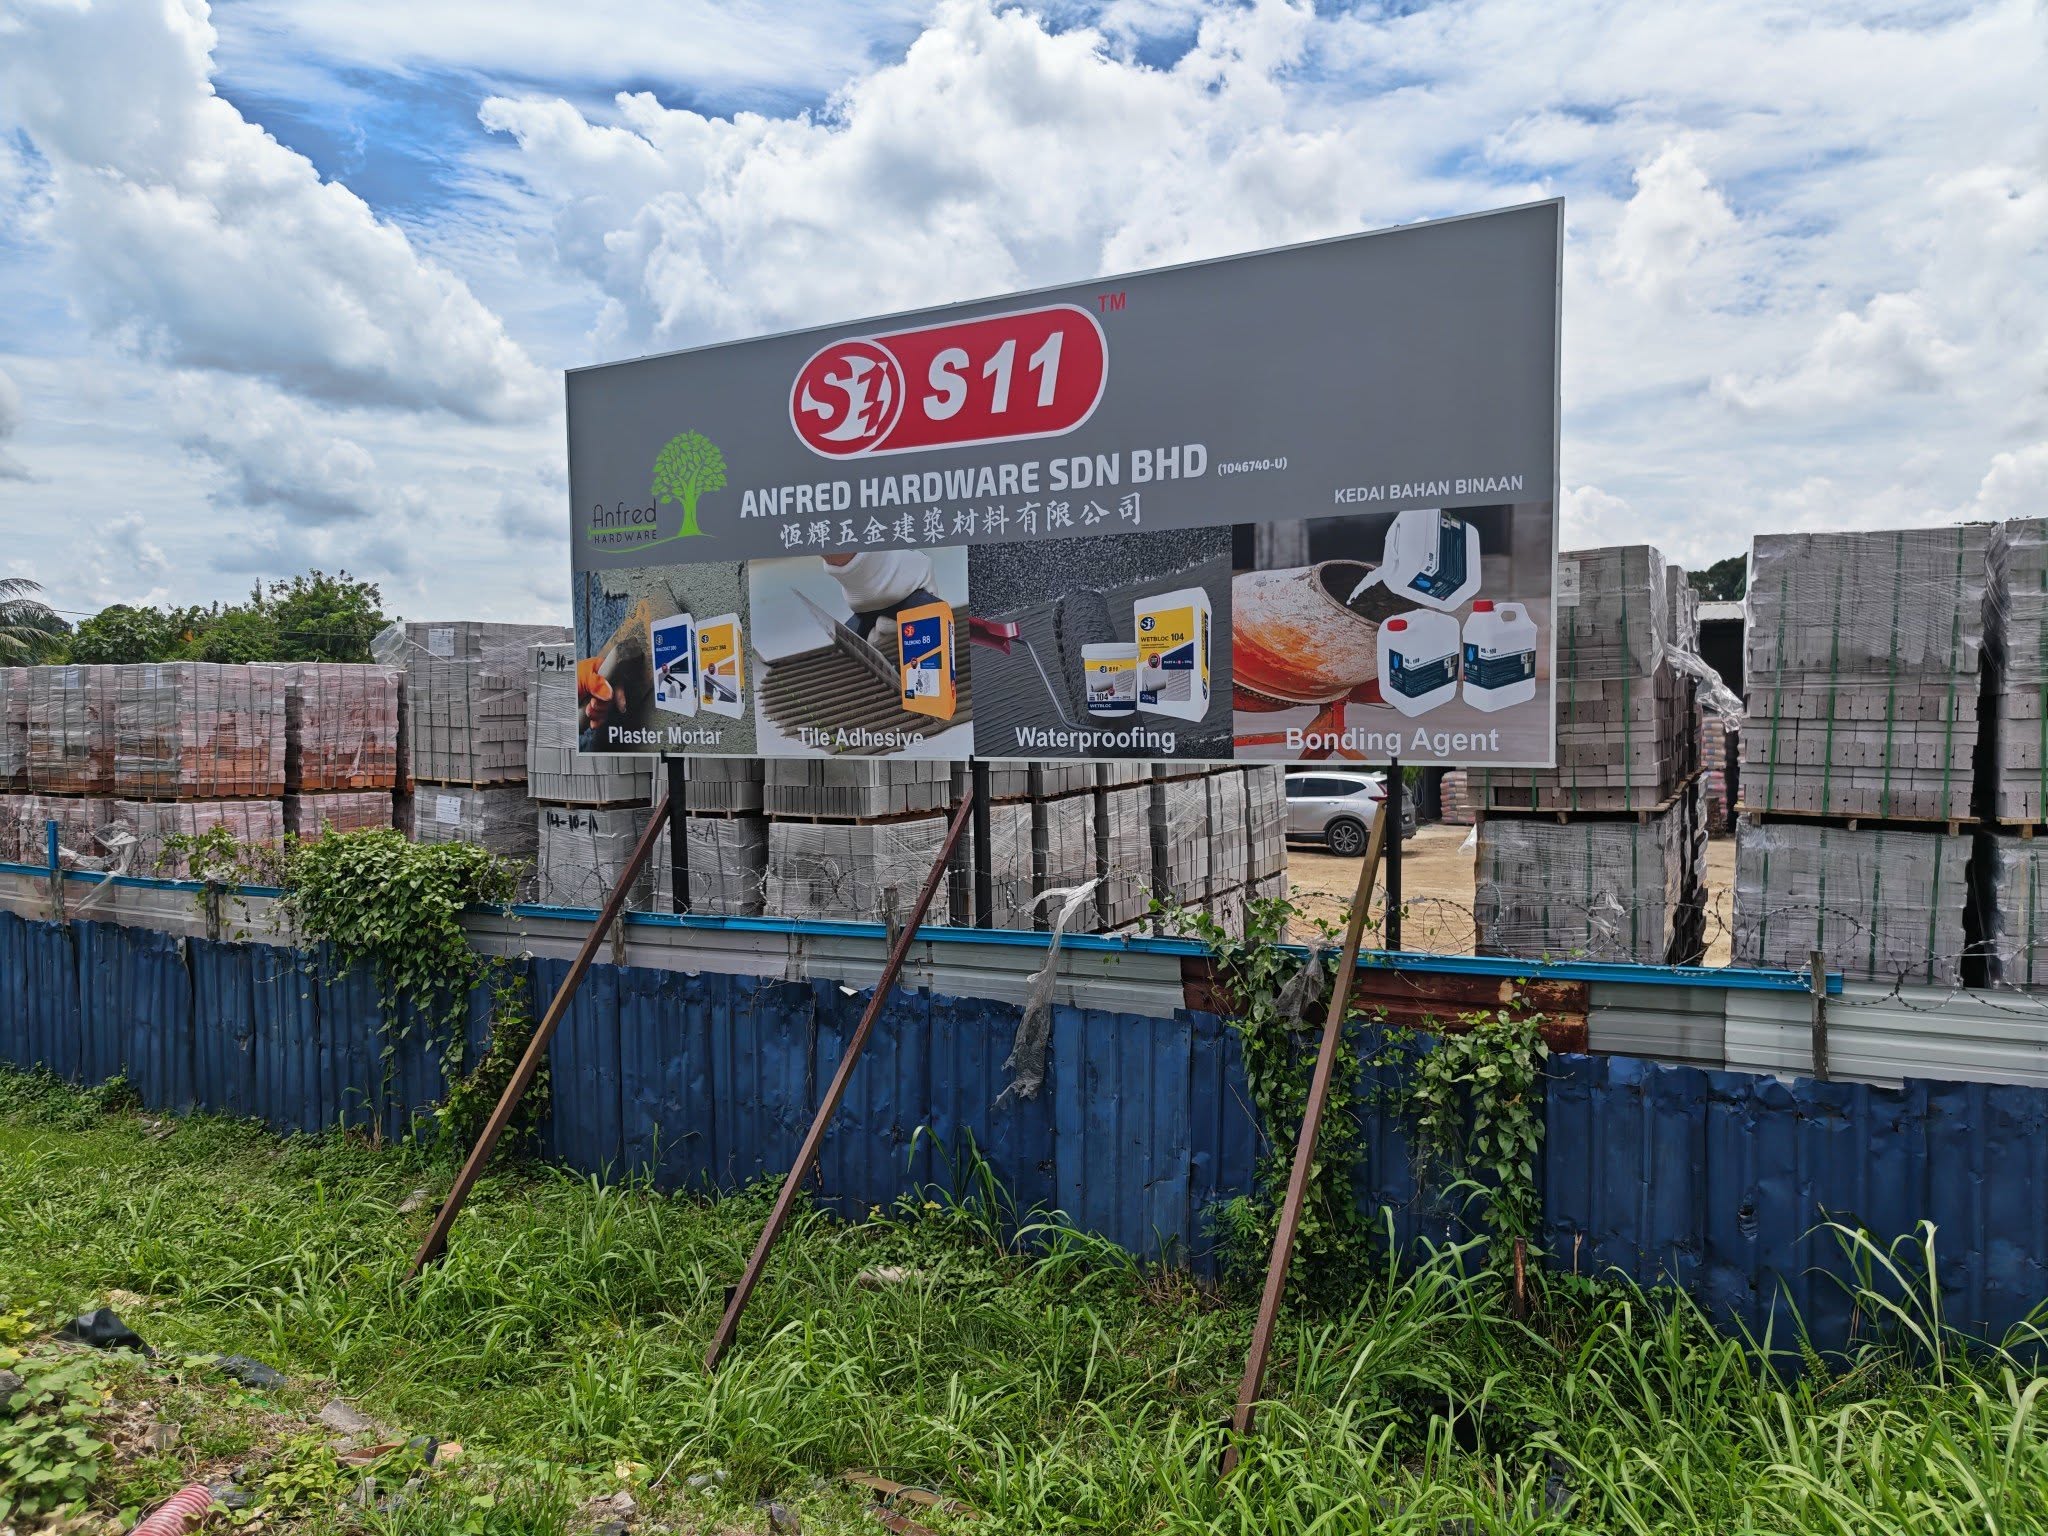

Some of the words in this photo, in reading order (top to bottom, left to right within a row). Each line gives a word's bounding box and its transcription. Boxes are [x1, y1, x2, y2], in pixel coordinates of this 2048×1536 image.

[1098, 291, 1126, 313] TM
[922, 331, 1064, 421] S11
[740, 481, 852, 519] ANFRED
[859, 462, 1040, 508] HARDWARE
[1048, 453, 1120, 492] SDN
[1131, 443, 1208, 484] BHD
[1217, 456, 1288, 477] (1046740-U)
[1334, 485, 1385, 504] KEDAI
[1389, 480, 1450, 500] BAHAN
[1455, 474, 1523, 495] BINAAN
[592, 498, 657, 528] Anfred
[594, 529, 657, 545] HARDWARE
[1140, 635, 1169, 643] WETBLOC
[1171, 633, 1184, 641] 104
[1096, 692, 1109, 701] 104
[608, 726, 663, 745] Plaster
[667, 726, 723, 746] Mortar
[797, 727, 830, 747] Tile
[834, 727, 924, 747] Adhesive
[1015, 726, 1176, 754] Waterproofing
[1286, 727, 1401, 758] Bonding
[1410, 727, 1500, 757] Agent
